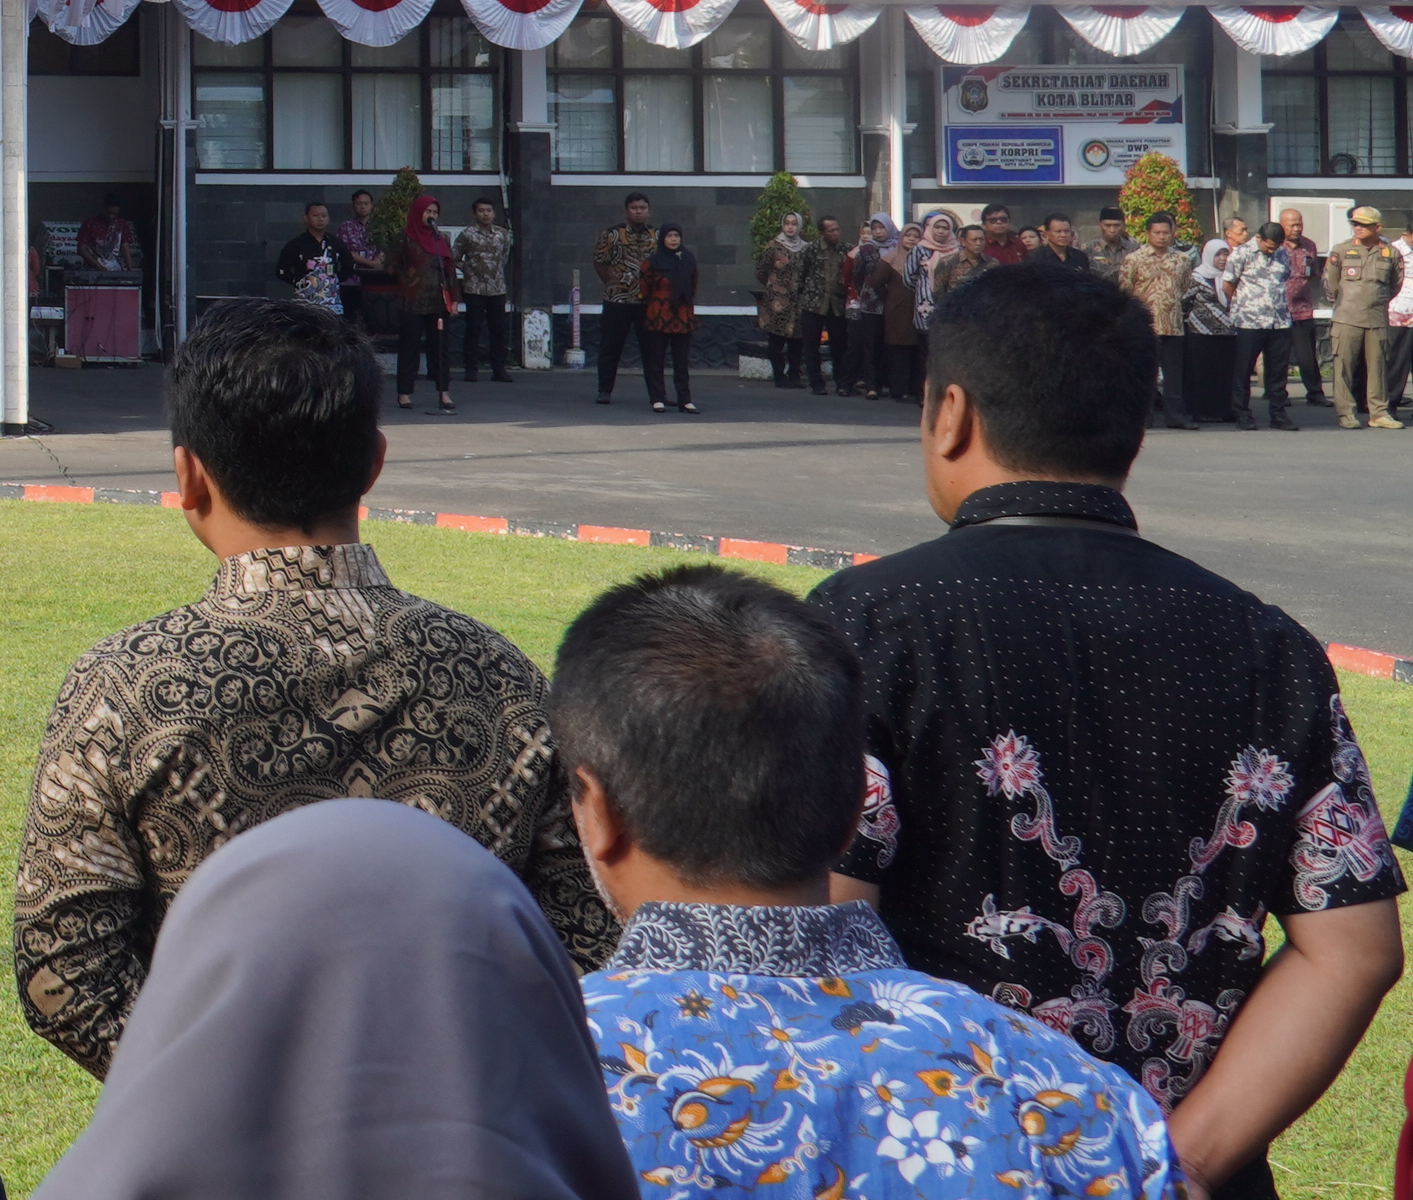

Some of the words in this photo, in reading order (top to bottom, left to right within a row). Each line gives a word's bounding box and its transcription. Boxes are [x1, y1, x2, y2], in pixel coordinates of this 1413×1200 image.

[1001, 75, 1105, 89] SEKRETARIAT
[1109, 74, 1168, 88] DAERAH
[1037, 93, 1076, 107] KOTA
[1080, 92, 1134, 106] BLITAR
[1001, 148, 1039, 157] KORPRI
[1127, 144, 1149, 152] DWP
